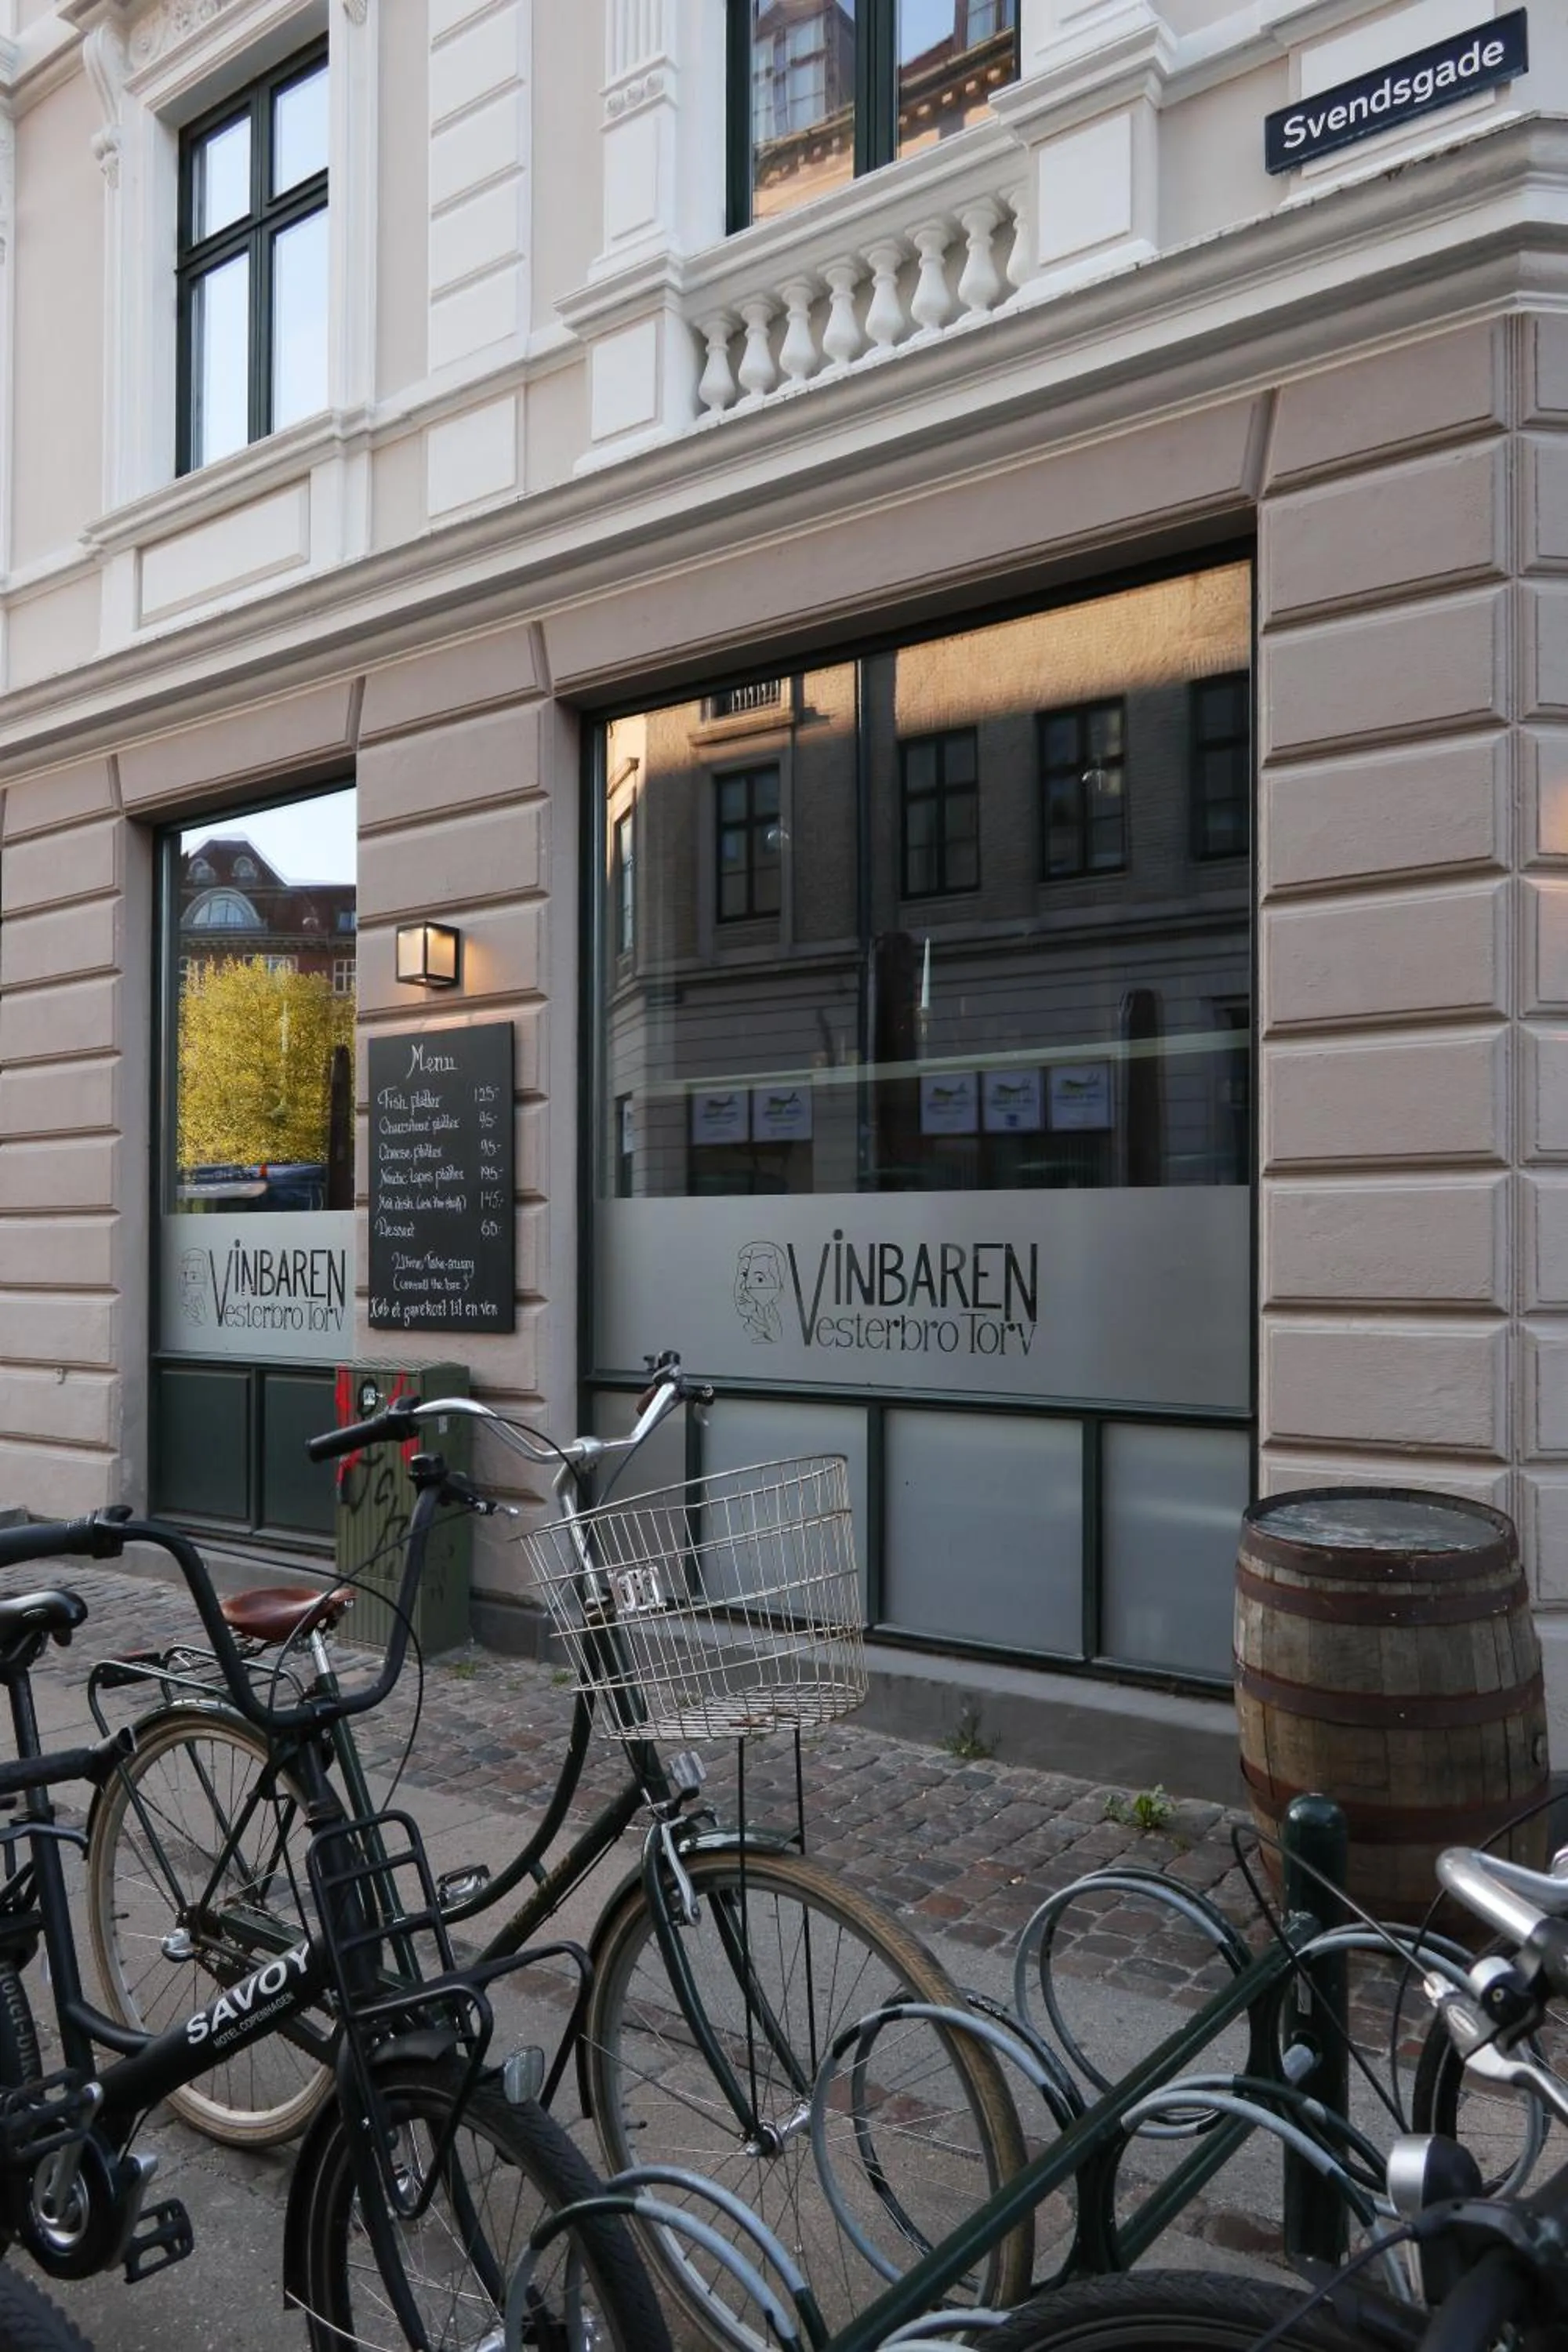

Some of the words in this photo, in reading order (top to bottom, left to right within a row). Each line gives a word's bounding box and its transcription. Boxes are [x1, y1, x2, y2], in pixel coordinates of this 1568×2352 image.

[1283, 38, 1504, 149] Svendsgade
[406, 1044, 459, 1079] Menu
[377, 1085, 408, 1109] Fish
[305, 1301, 344, 1331] Torv
[960, 1313, 1038, 1356] Torv
[186, 1942, 310, 2044] SAVOY
[213, 2028, 241, 2049] HOTEL
